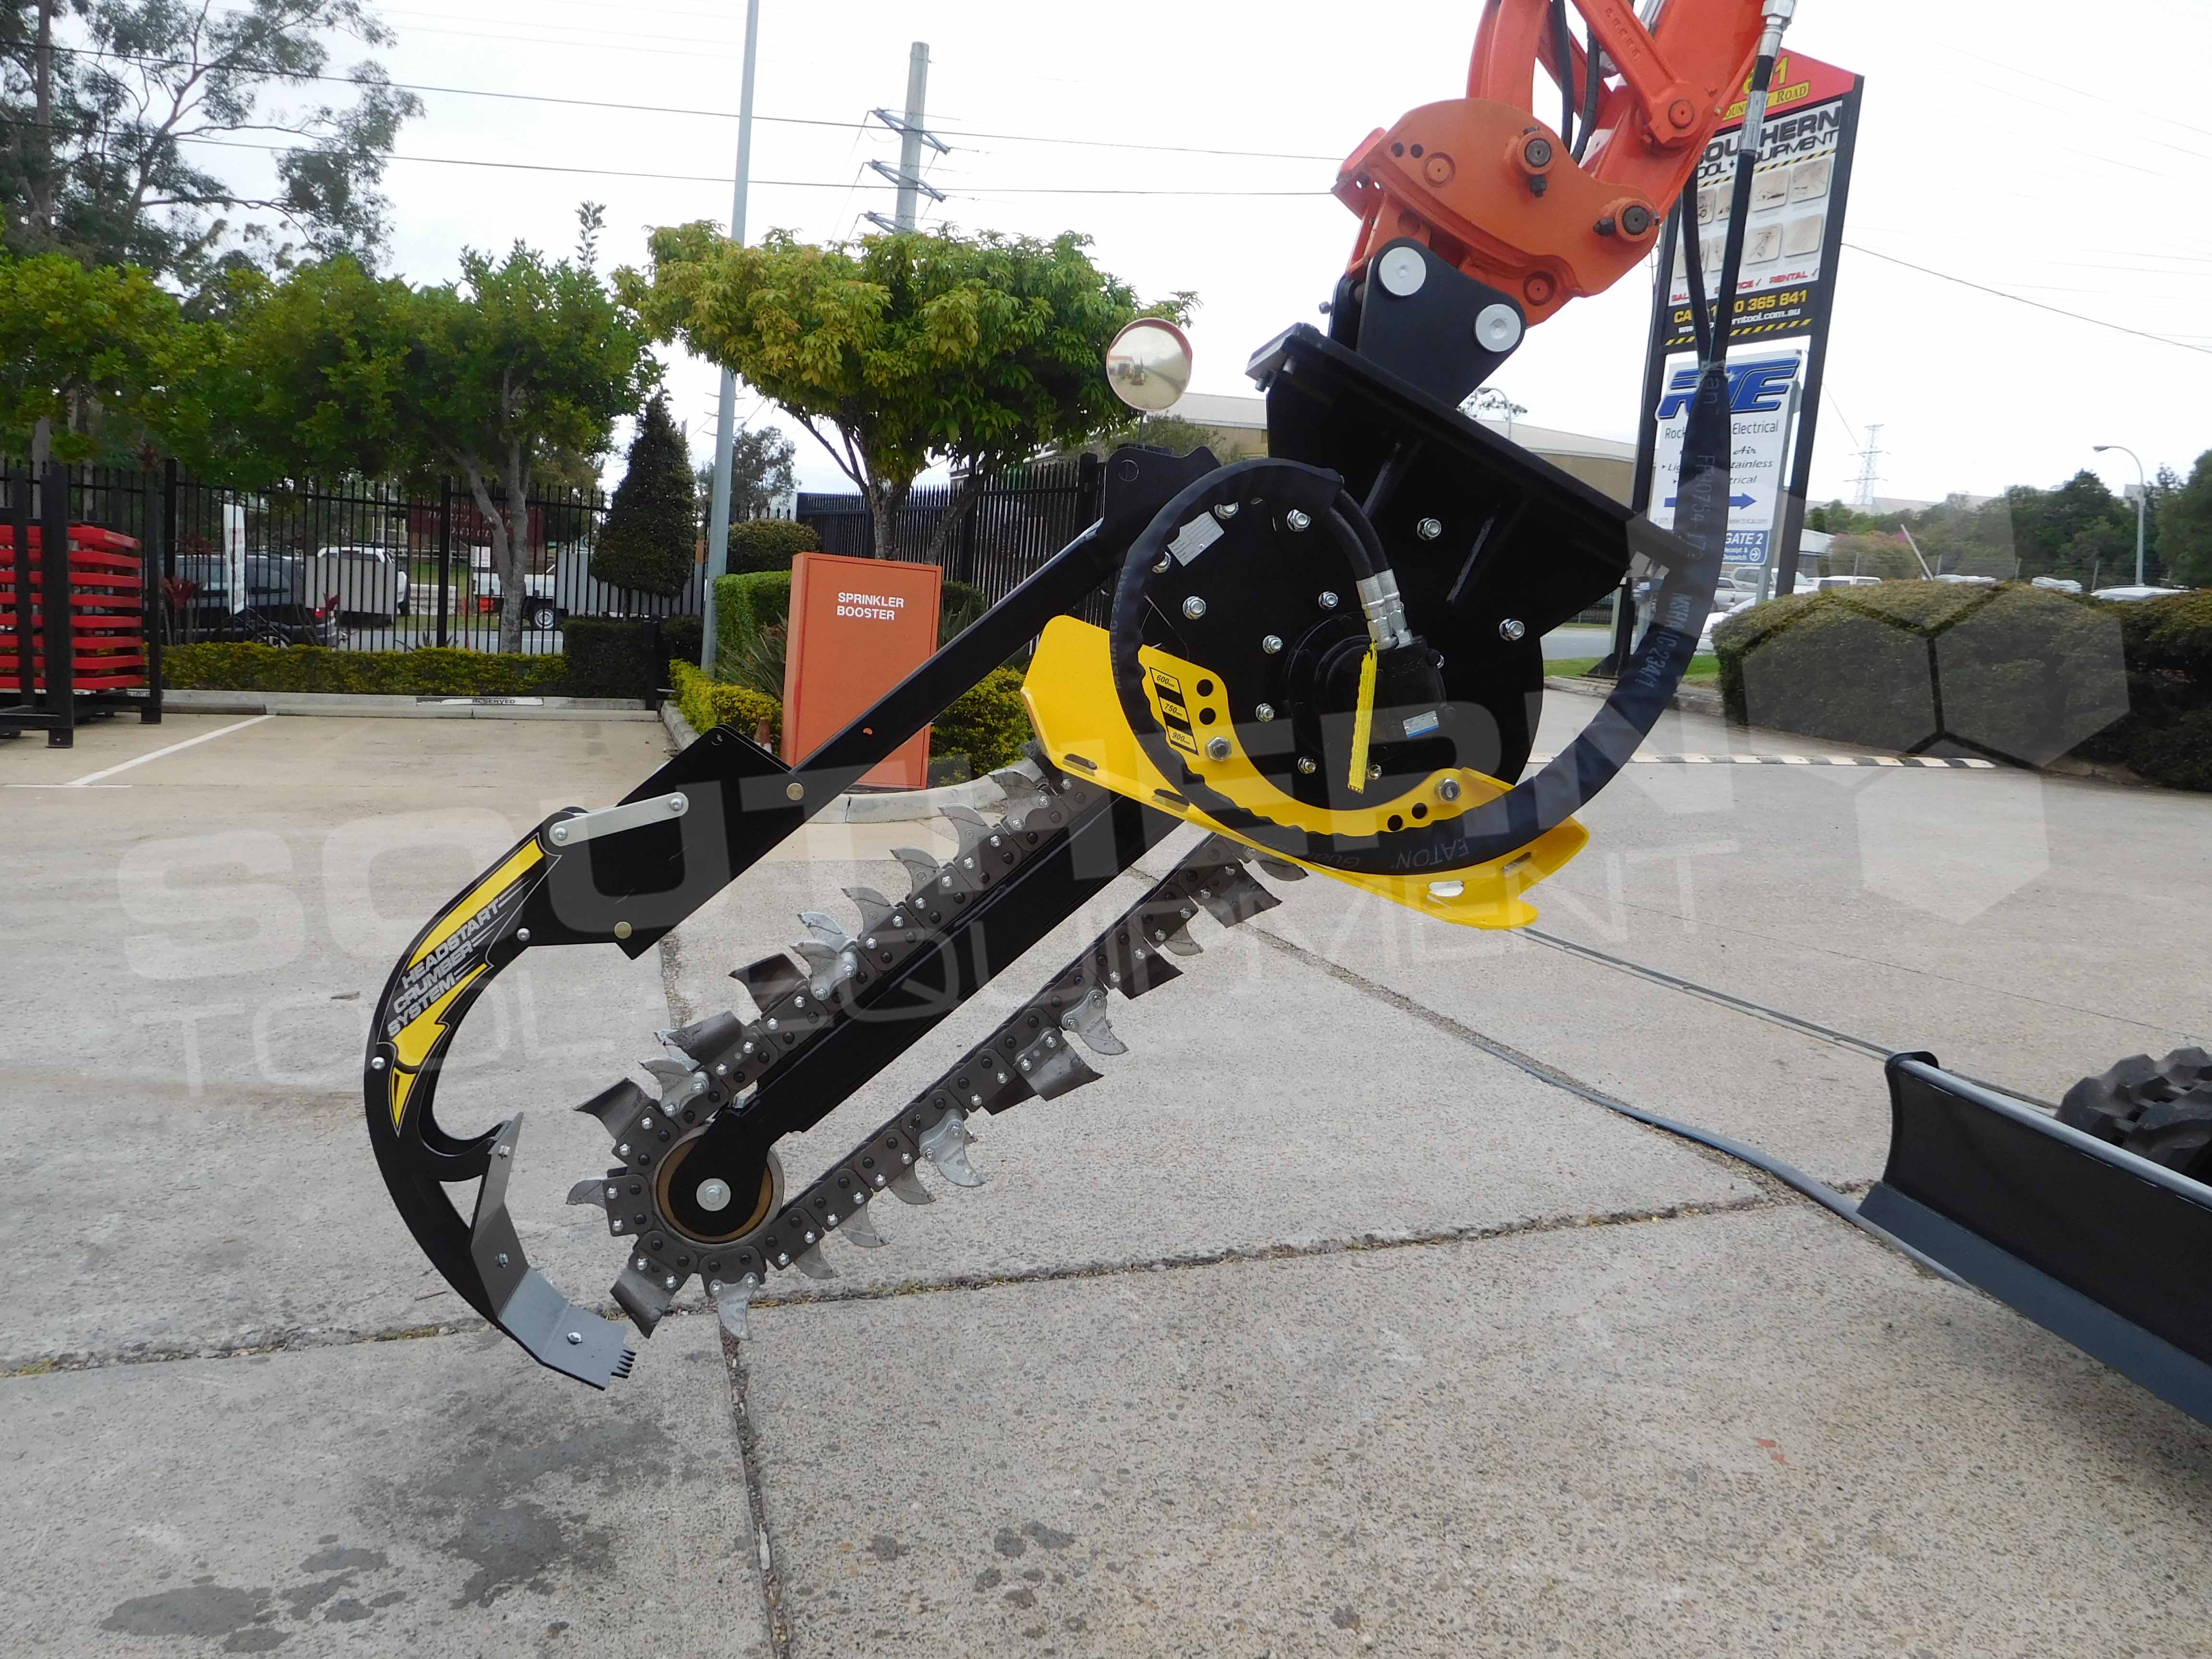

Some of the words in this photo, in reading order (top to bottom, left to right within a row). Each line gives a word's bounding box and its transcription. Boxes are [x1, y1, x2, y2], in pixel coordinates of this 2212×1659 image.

[1699, 106, 1841, 165] OUHERN
[1698, 162, 1727, 179] OOL
[1769, 271, 1808, 284] RENTAL
[1748, 295, 1776, 311] 365
[1779, 289, 1808, 305] 841
[1732, 420, 1779, 434] Electrical
[1731, 460, 1773, 469] tainless
[1725, 532, 1755, 544] GATE
[1755, 533, 1763, 544] 2
[838, 592, 904, 608] SPRINKLER
[837, 605, 895, 620] BOOSTER
[1395, 837, 1470, 870] EATON
[402, 898, 499, 989] HEADSTART
[394, 940, 474, 1014] CRUMBER
[387, 974, 456, 1037] SYSTEM
